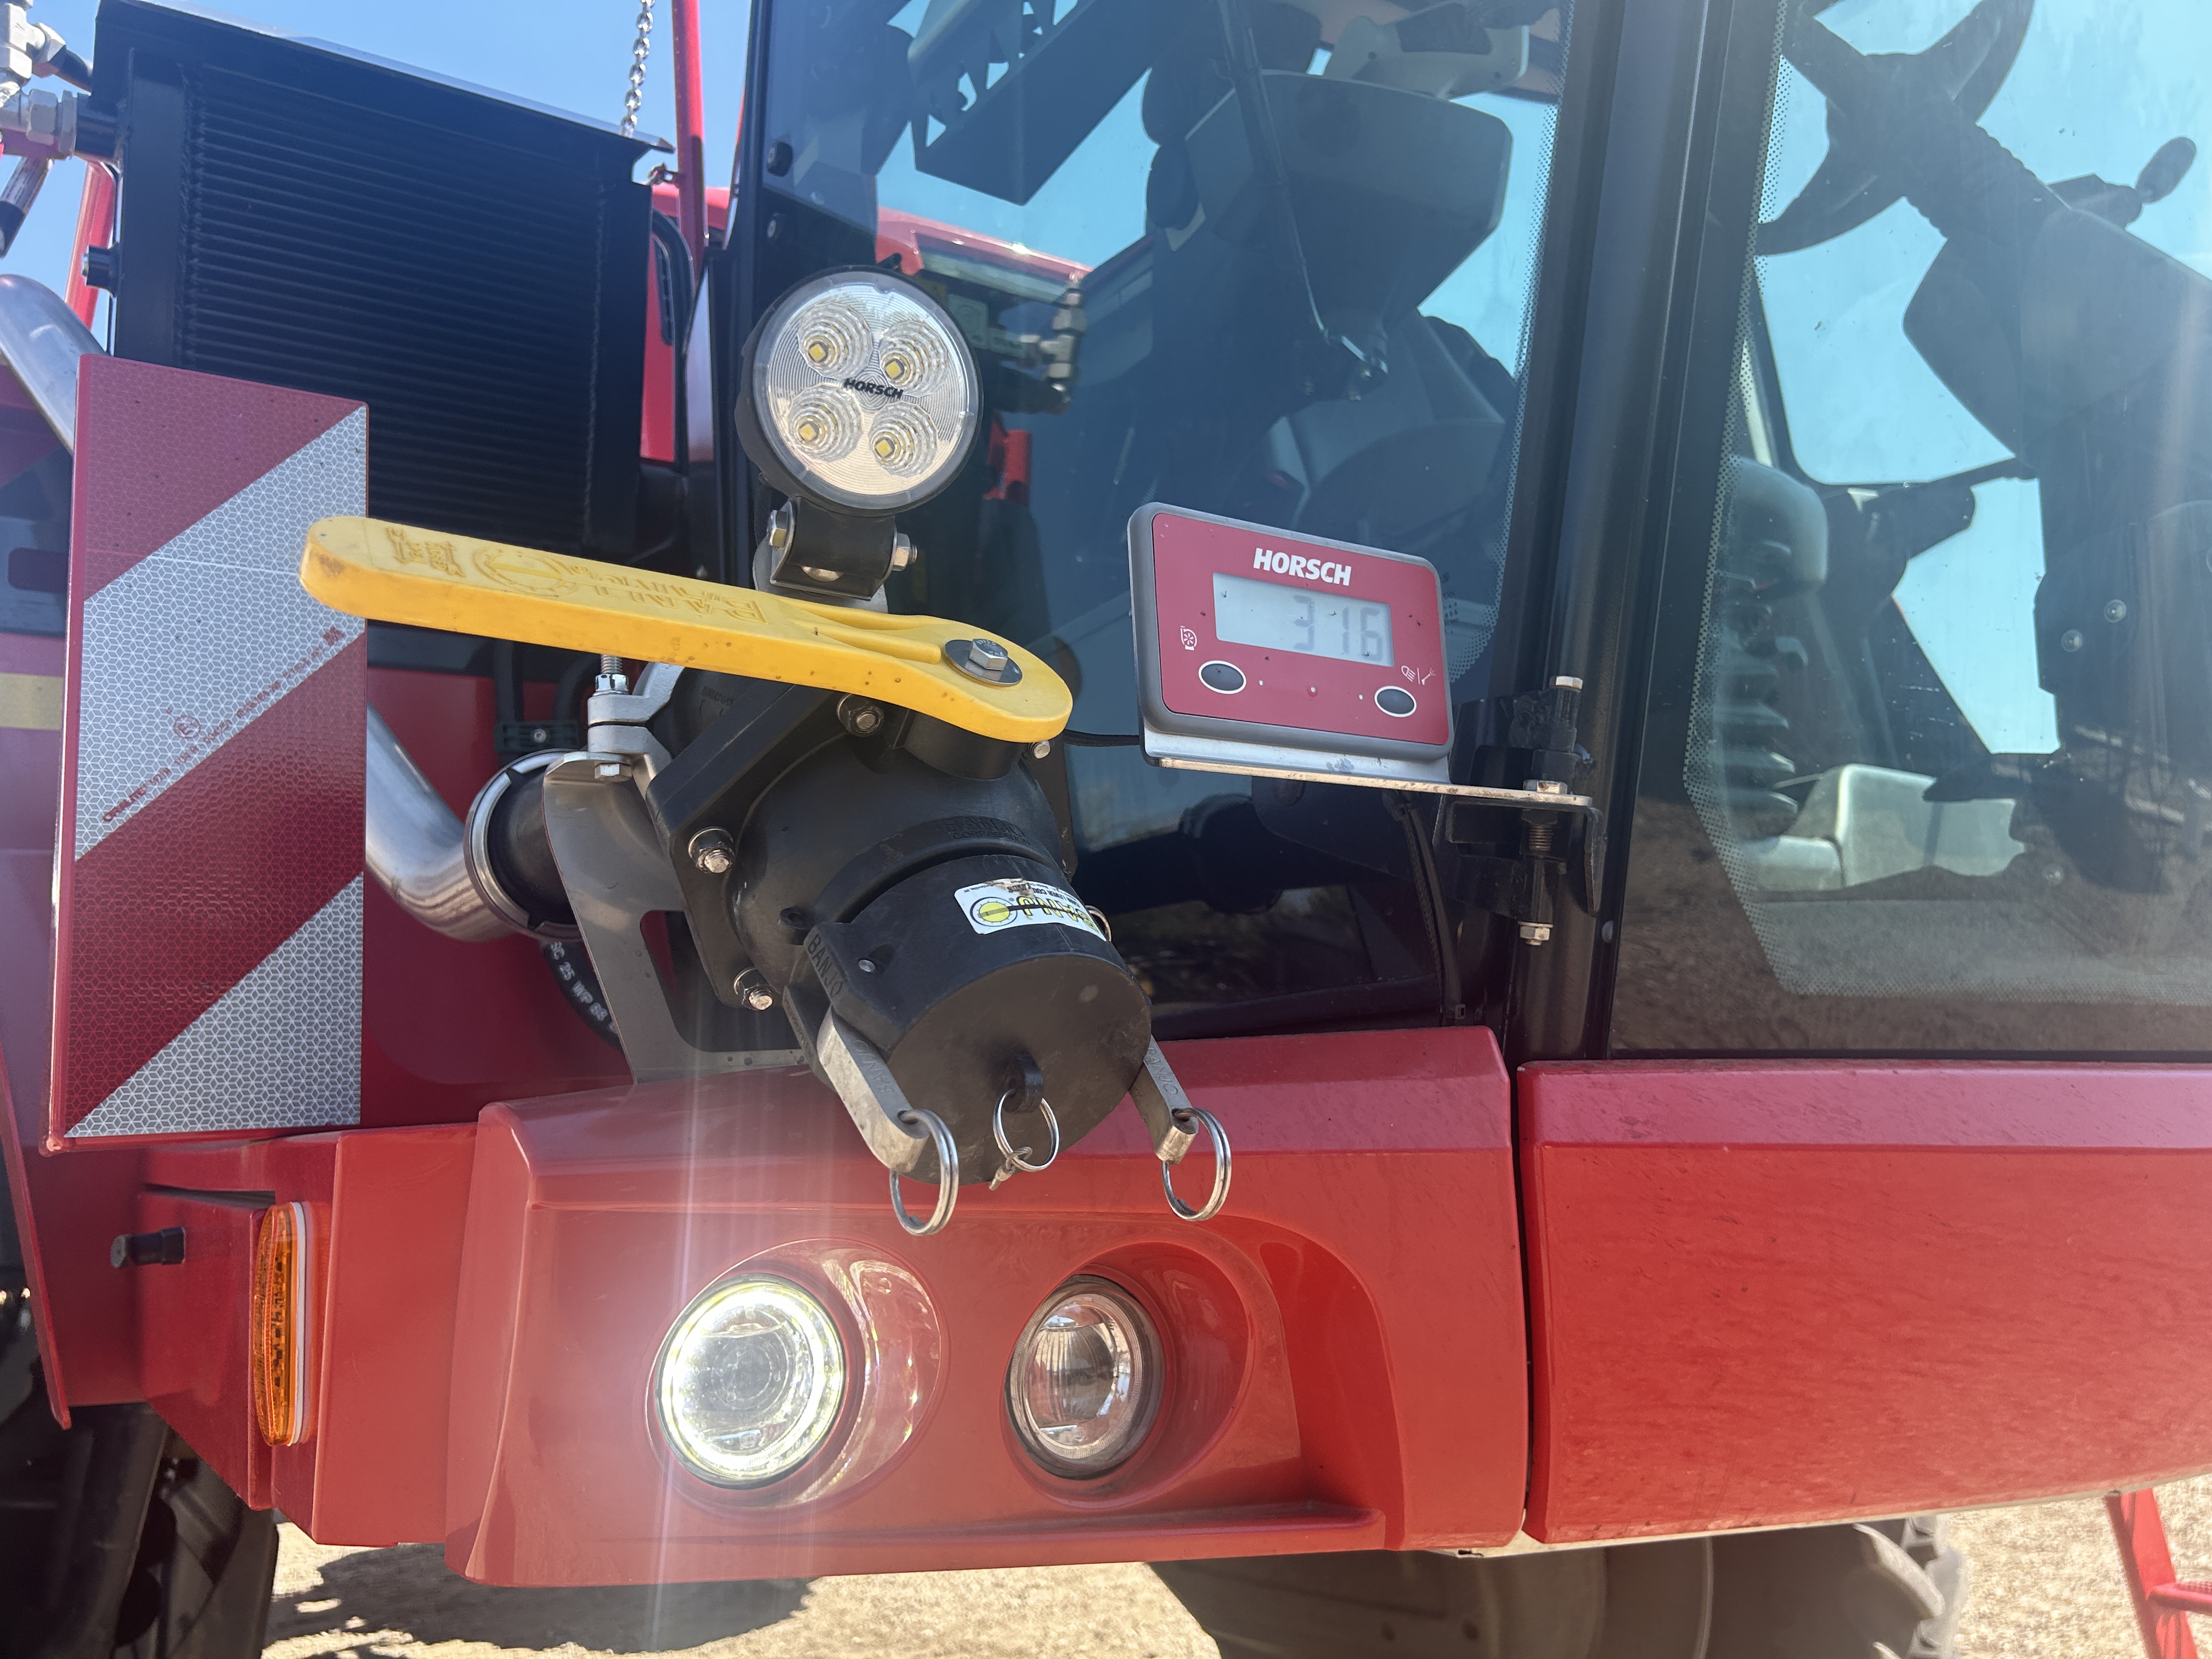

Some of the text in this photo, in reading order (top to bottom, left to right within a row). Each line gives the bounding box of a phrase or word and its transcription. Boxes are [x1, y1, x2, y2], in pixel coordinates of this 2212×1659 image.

[843, 379, 904, 399] HORSCH
[1253, 548, 1352, 586] HORSCH
[1292, 594, 1385, 662] 316
[808, 933, 843, 997] BANJO
